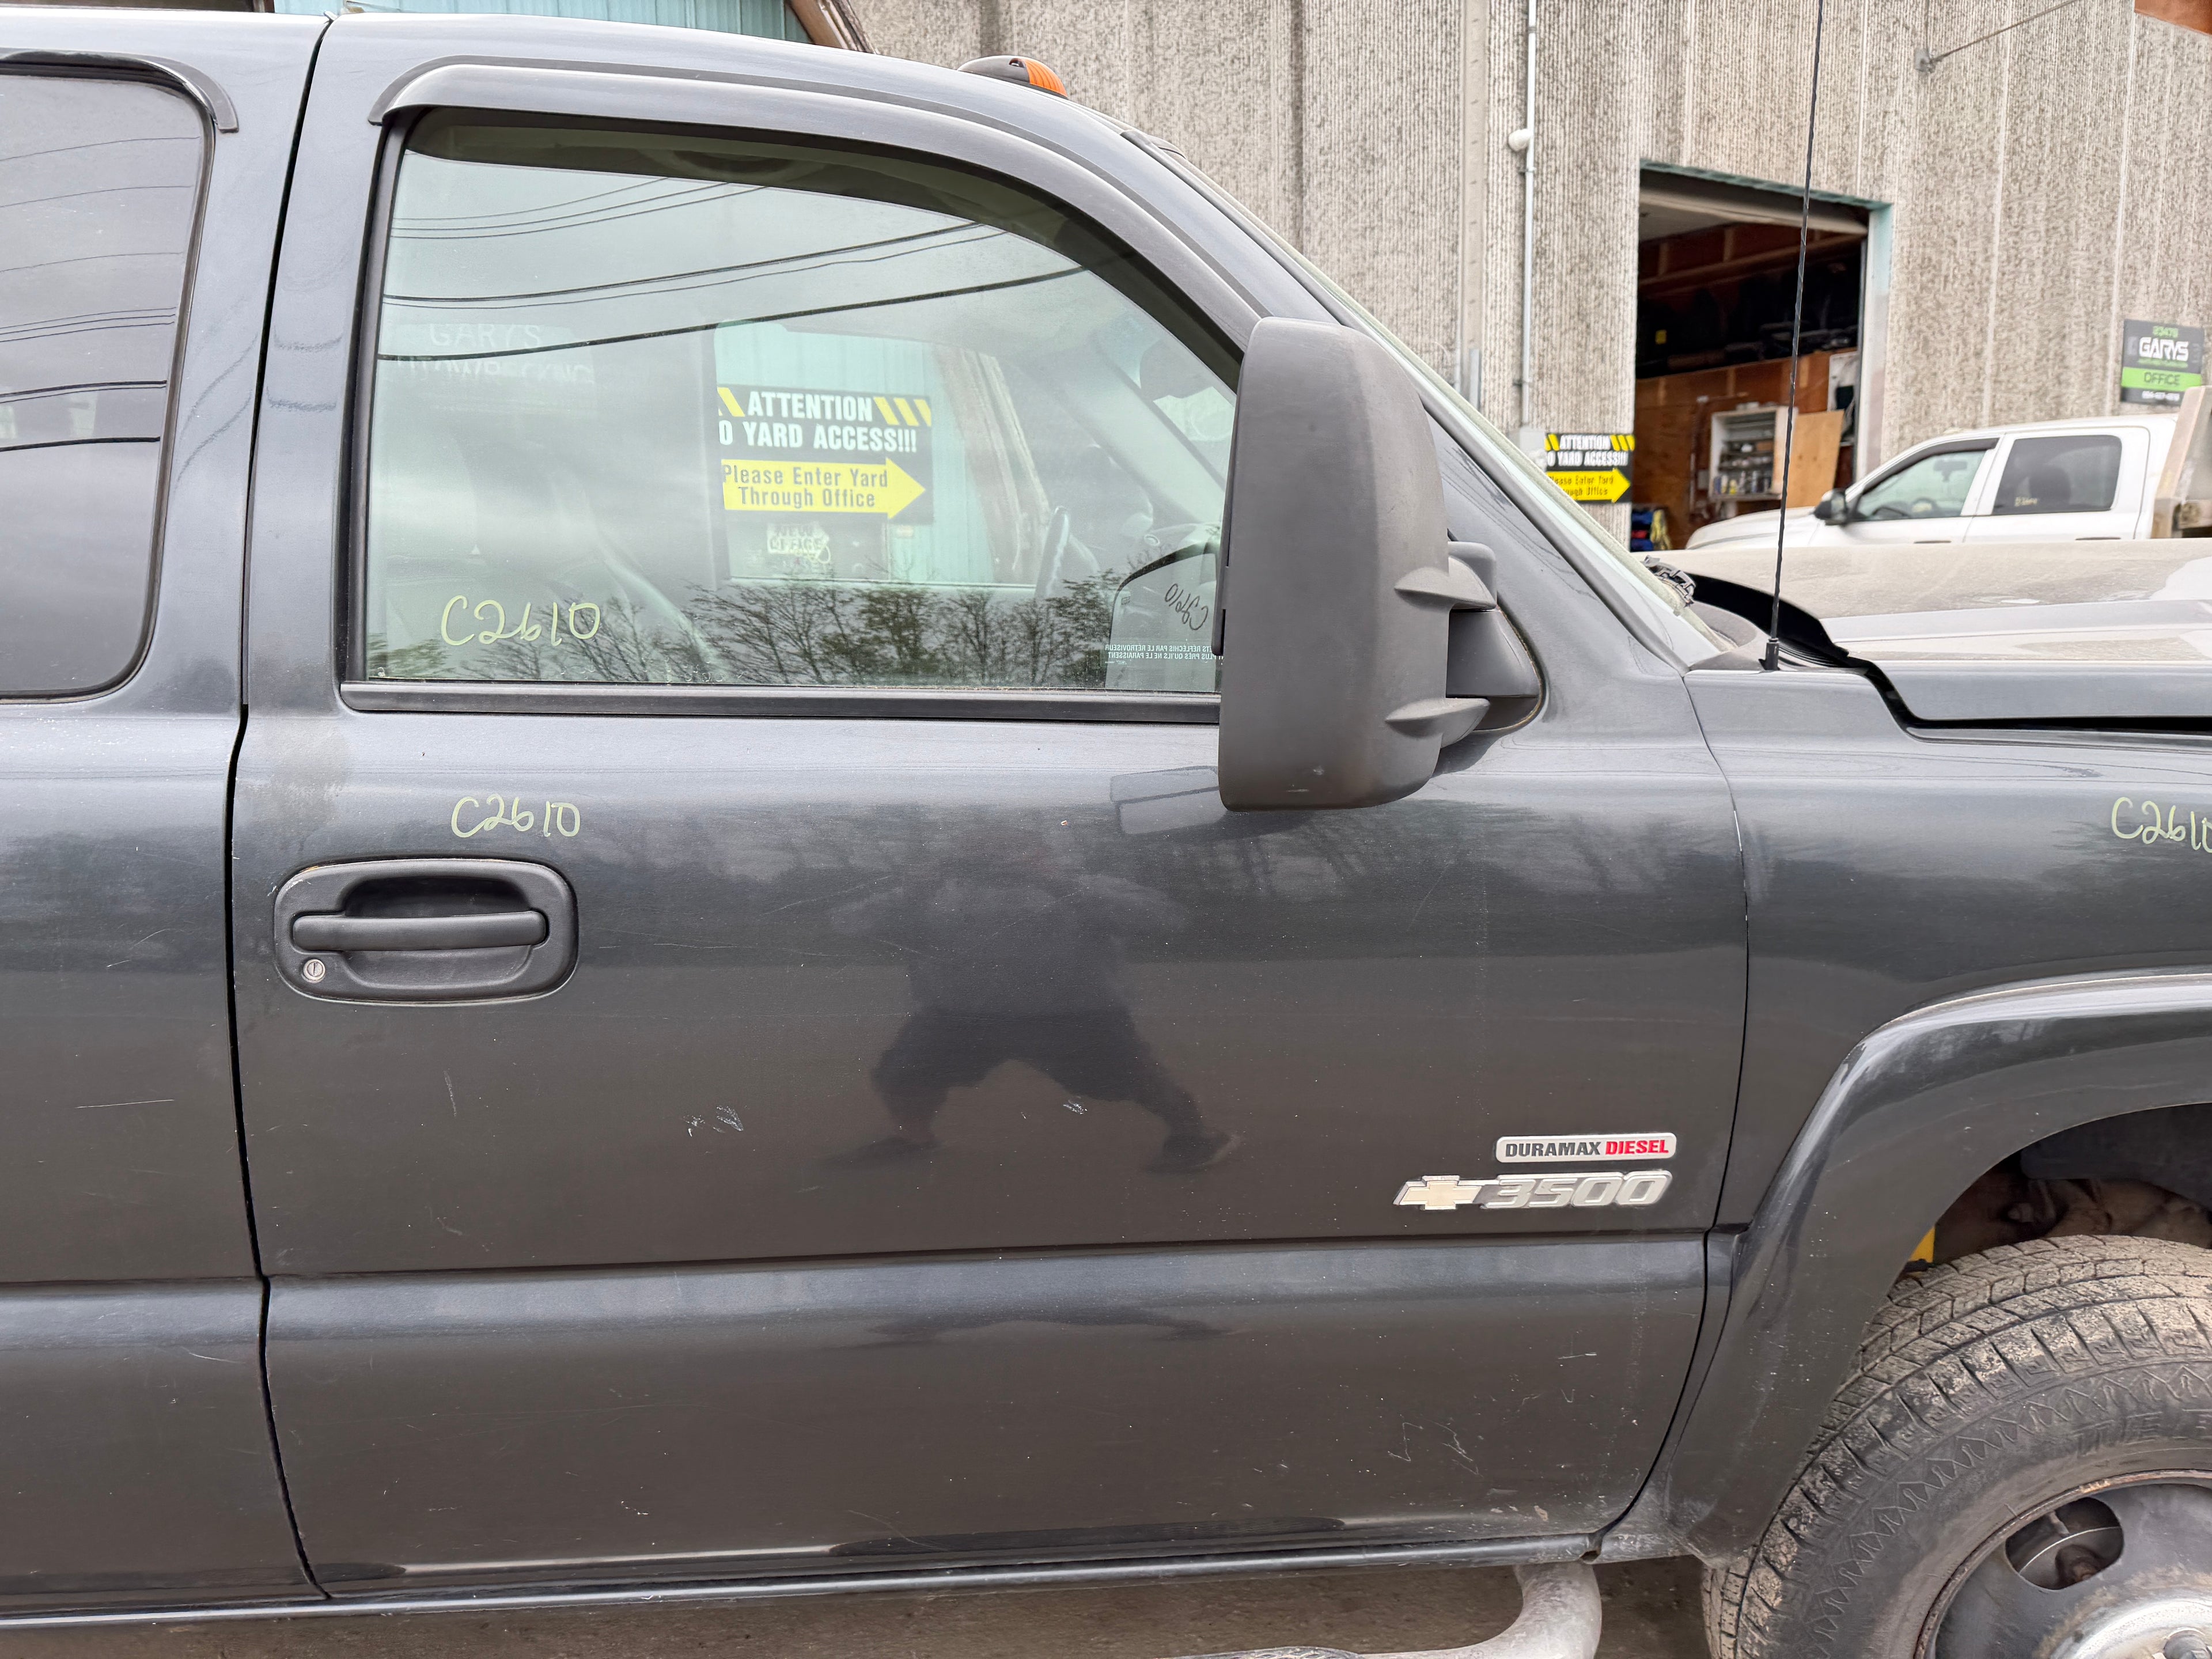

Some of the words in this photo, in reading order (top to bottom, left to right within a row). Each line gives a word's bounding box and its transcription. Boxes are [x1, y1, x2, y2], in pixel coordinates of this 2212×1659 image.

[2139, 336, 2189, 362] GARYS
[2144, 372, 2180, 385] OFFICE
[747, 391, 873, 422] ATTENTION
[719, 420, 733, 445] O
[742, 421, 803, 448] YARD
[813, 423, 917, 452] ACCESS!!!
[1559, 434, 1611, 450] ATTENTION
[1547, 450, 1555, 467] O
[1557, 450, 1583, 466] YARD
[1584, 450, 1629, 466] ACCESS!!!
[722, 464, 783, 484] Please
[793, 466, 841, 486] Enter
[850, 468, 888, 487] Yard
[1575, 475, 1594, 484] Enter
[1599, 475, 1613, 484] Yard
[738, 486, 813, 509] Through
[822, 488, 876, 507] Office
[1586, 486, 1608, 495] Office
[441, 595, 600, 645] C2610
[451, 794, 581, 838] C2610
[1505, 1141, 1601, 1157] DURAMAX
[1605, 1139, 1669, 1154] DIESEL
[1485, 1171, 1672, 1209] 3500
